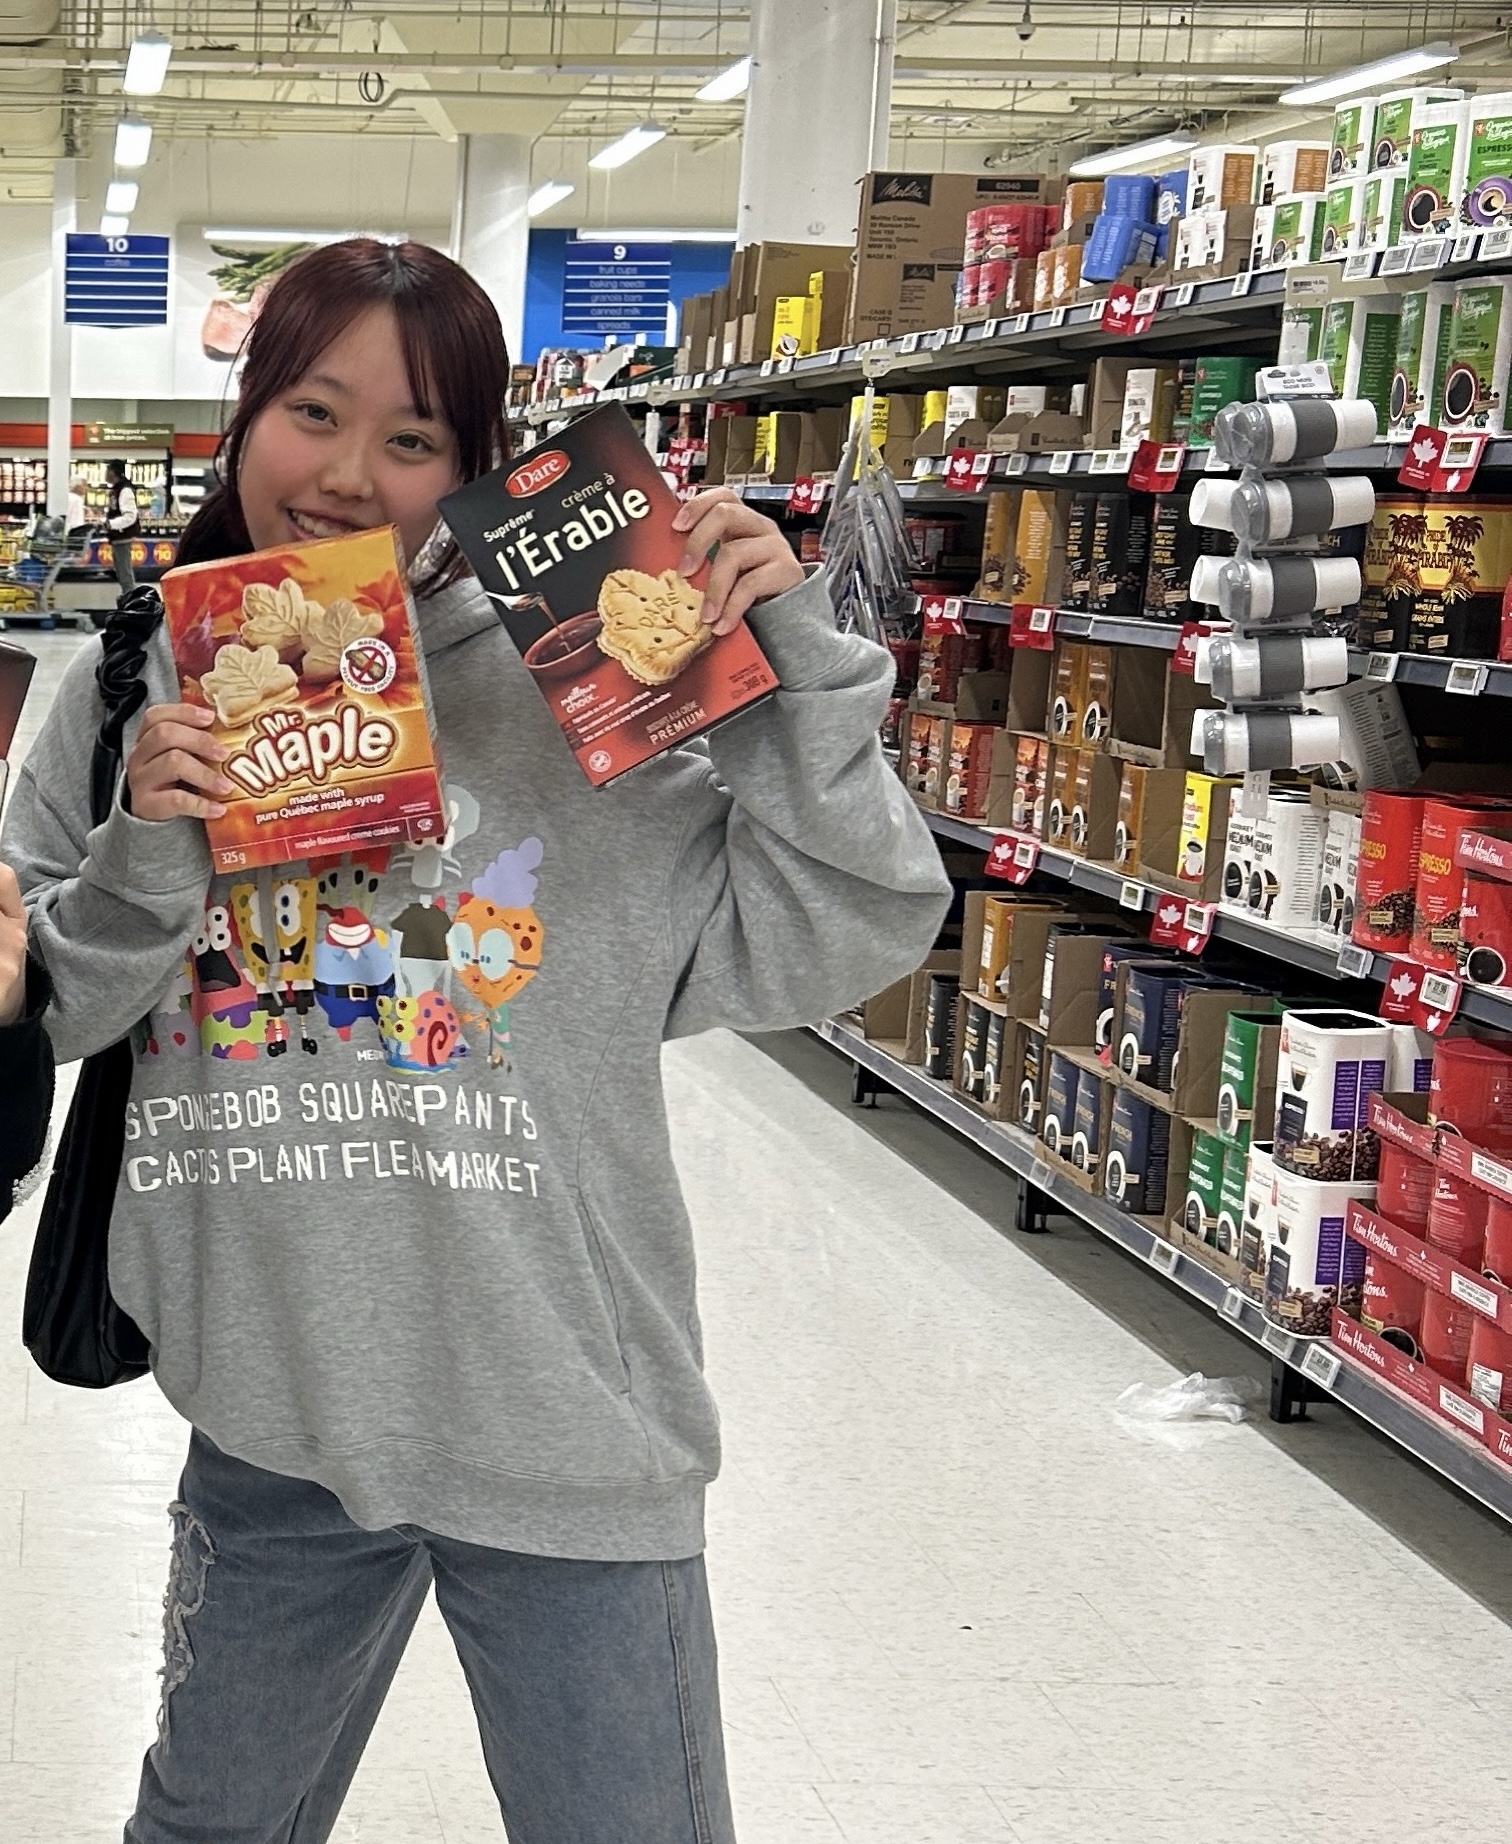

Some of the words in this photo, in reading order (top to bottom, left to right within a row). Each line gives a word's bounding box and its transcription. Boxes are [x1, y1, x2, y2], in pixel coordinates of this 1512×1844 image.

[106, 237, 129, 253] 10
[613, 245, 627, 260] 9
[589, 280, 618, 290] baking
[590, 308, 622, 316] canned
[623, 307, 642, 315] milk
[515, 457, 562, 493] Dare
[560, 480, 604, 510] crème
[603, 472, 617, 488] à
[495, 488, 652, 591] l'Érable
[261, 711, 304, 739] Mr.
[229, 706, 396, 792] Maple
[255, 811, 279, 826] pure
[279, 801, 320, 820] Québec
[320, 796, 354, 813] maple
[354, 791, 386, 810] syrup
[288, 791, 319, 806] made
[320, 787, 345, 802] with
[294, 837, 317, 851] maple
[372, 824, 401, 838] cookies
[1460, 832, 1474, 856] Tim
[1472, 837, 1504, 868] Hortons
[221, 852, 239, 866] 325
[239, 851, 247, 866] g
[300, 1079, 538, 1140] SQUAREPANTS
[227, 1143, 330, 1184] PLANT
[342, 1139, 425, 1179] FLEA
[425, 1150, 541, 1199] MARKET
[1352, 1211, 1367, 1240] Tim
[1365, 1223, 1399, 1258] Hortons
[1336, 1320, 1354, 1348] Tim
[1352, 1329, 1386, 1368] Hortons
